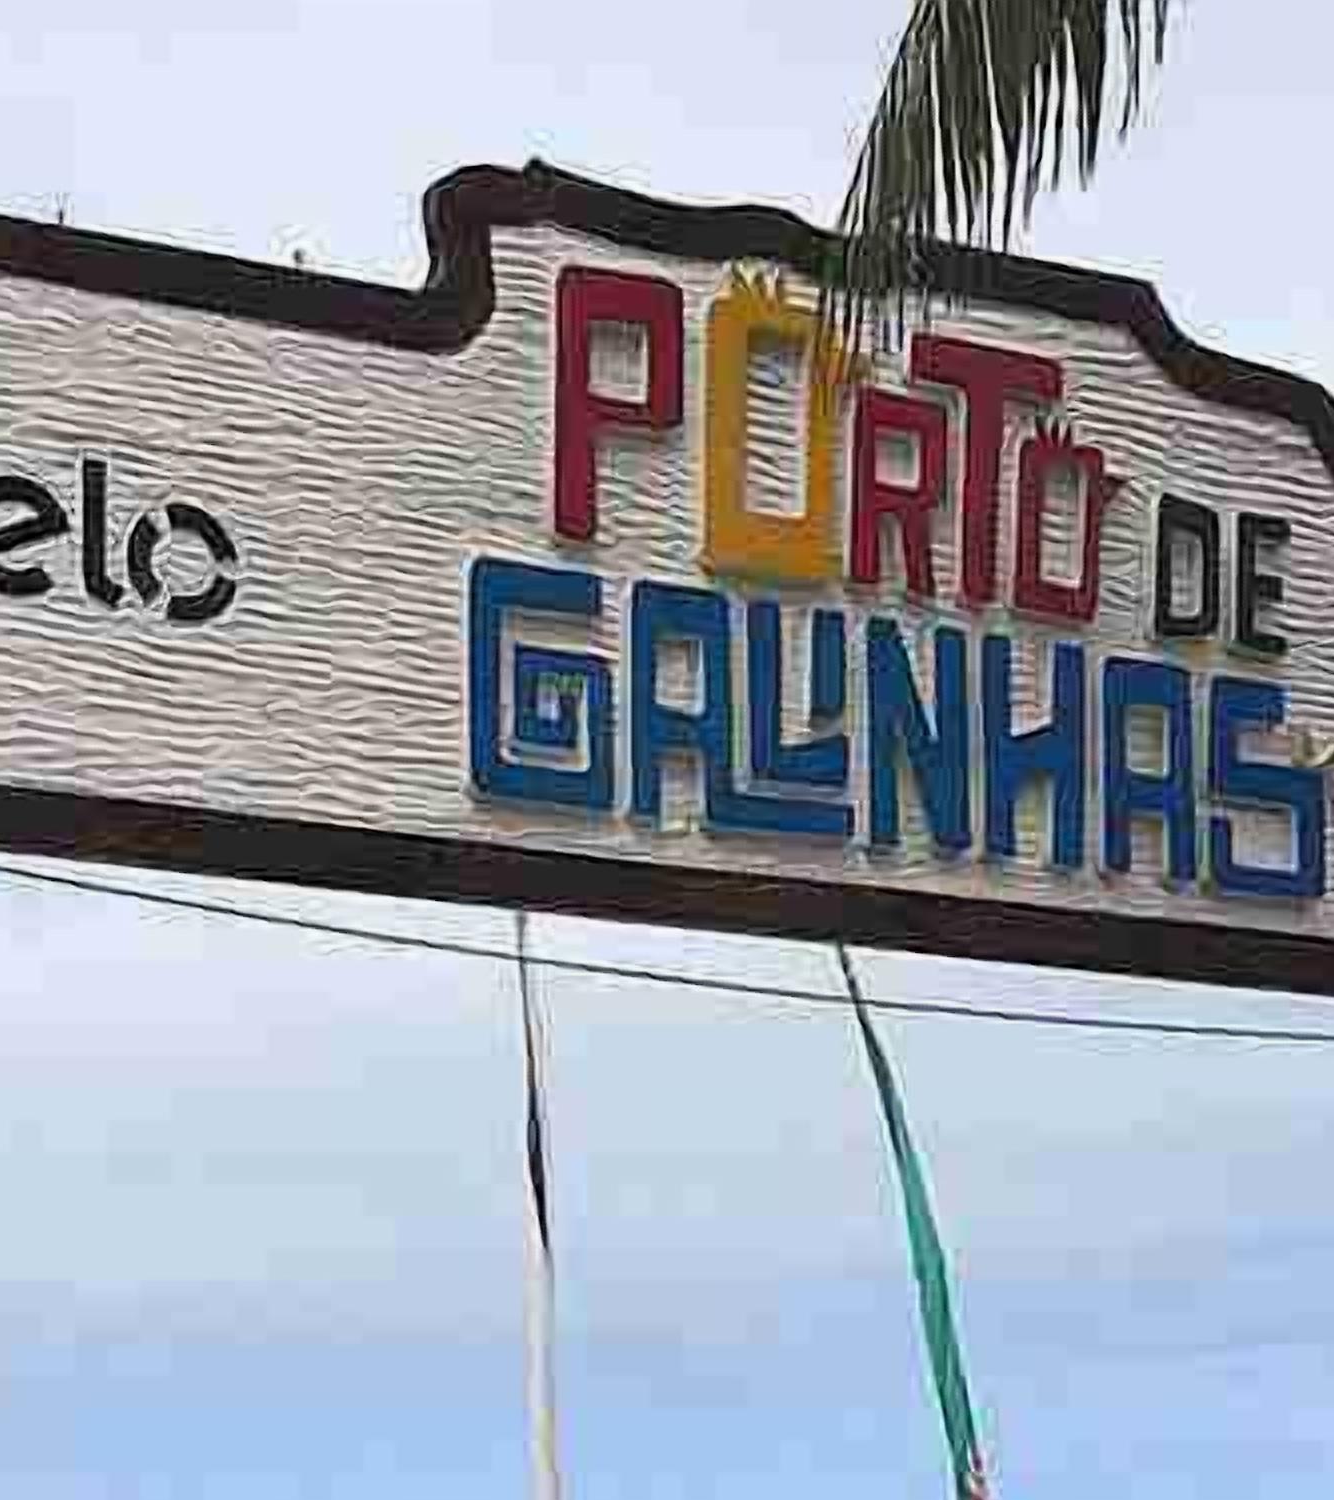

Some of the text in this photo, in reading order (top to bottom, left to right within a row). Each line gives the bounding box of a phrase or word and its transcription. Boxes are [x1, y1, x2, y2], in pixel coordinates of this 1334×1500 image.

[553, 262, 1290, 655] PORTO DE
[469, 558, 1329, 898] GALINHAS
